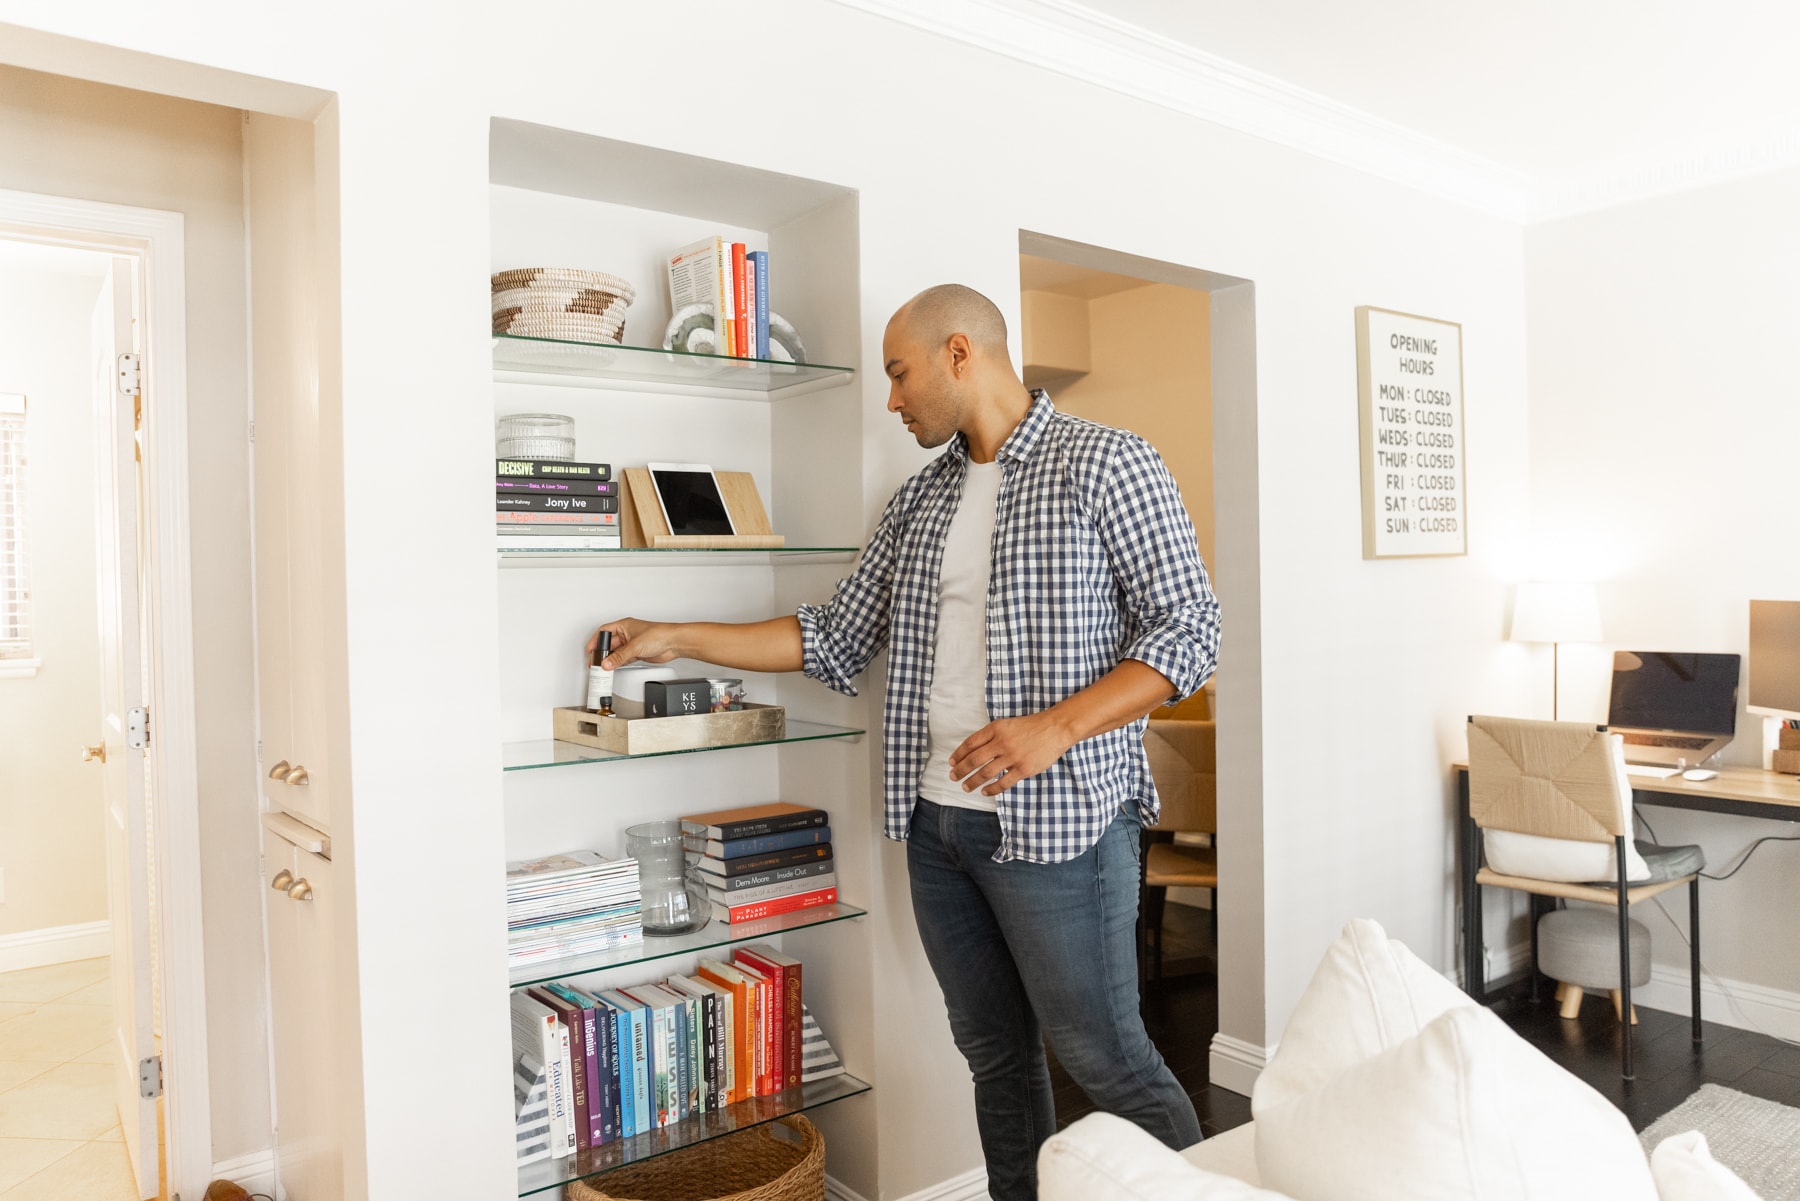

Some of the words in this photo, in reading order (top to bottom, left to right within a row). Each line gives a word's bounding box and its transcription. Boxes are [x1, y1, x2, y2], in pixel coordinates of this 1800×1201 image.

[1390, 333, 1438, 355] OPENING
[1400, 357, 1434, 376] HOURS
[1414, 388, 1452, 406] CLOSED
[1415, 409, 1453, 428] CLOSED
[1416, 432, 1454, 449] CLOSED
[498, 461, 535, 476] DECISIVE
[1416, 453, 1455, 470] CLOSED
[1417, 475, 1456, 491] CLOSED
[545, 497, 569, 510] Jony
[572, 498, 587, 508] Ive
[1418, 496, 1457, 512] CLOSED
[1419, 517, 1458, 533] CLOSED
[735, 879, 750, 887] Demi
[751, 875, 769, 884] Moore
[776, 870, 793, 879] Inside
[794, 868, 807, 876] Out
[736, 911, 767, 921] PARADOX
[610, 1012, 618, 1043] JOURNEY
[707, 998, 715, 1059] PAIN
[585, 1018, 596, 1057] inGenius
[635, 1022, 645, 1062] untamed
[612, 1044, 618, 1054] OF
[717, 1042, 725, 1070] Murray
[574, 1057, 582, 1073] Talk
[611, 1054, 619, 1076] SOULS
[552, 1060, 565, 1118] Educated
[576, 1090, 585, 1106] TED
